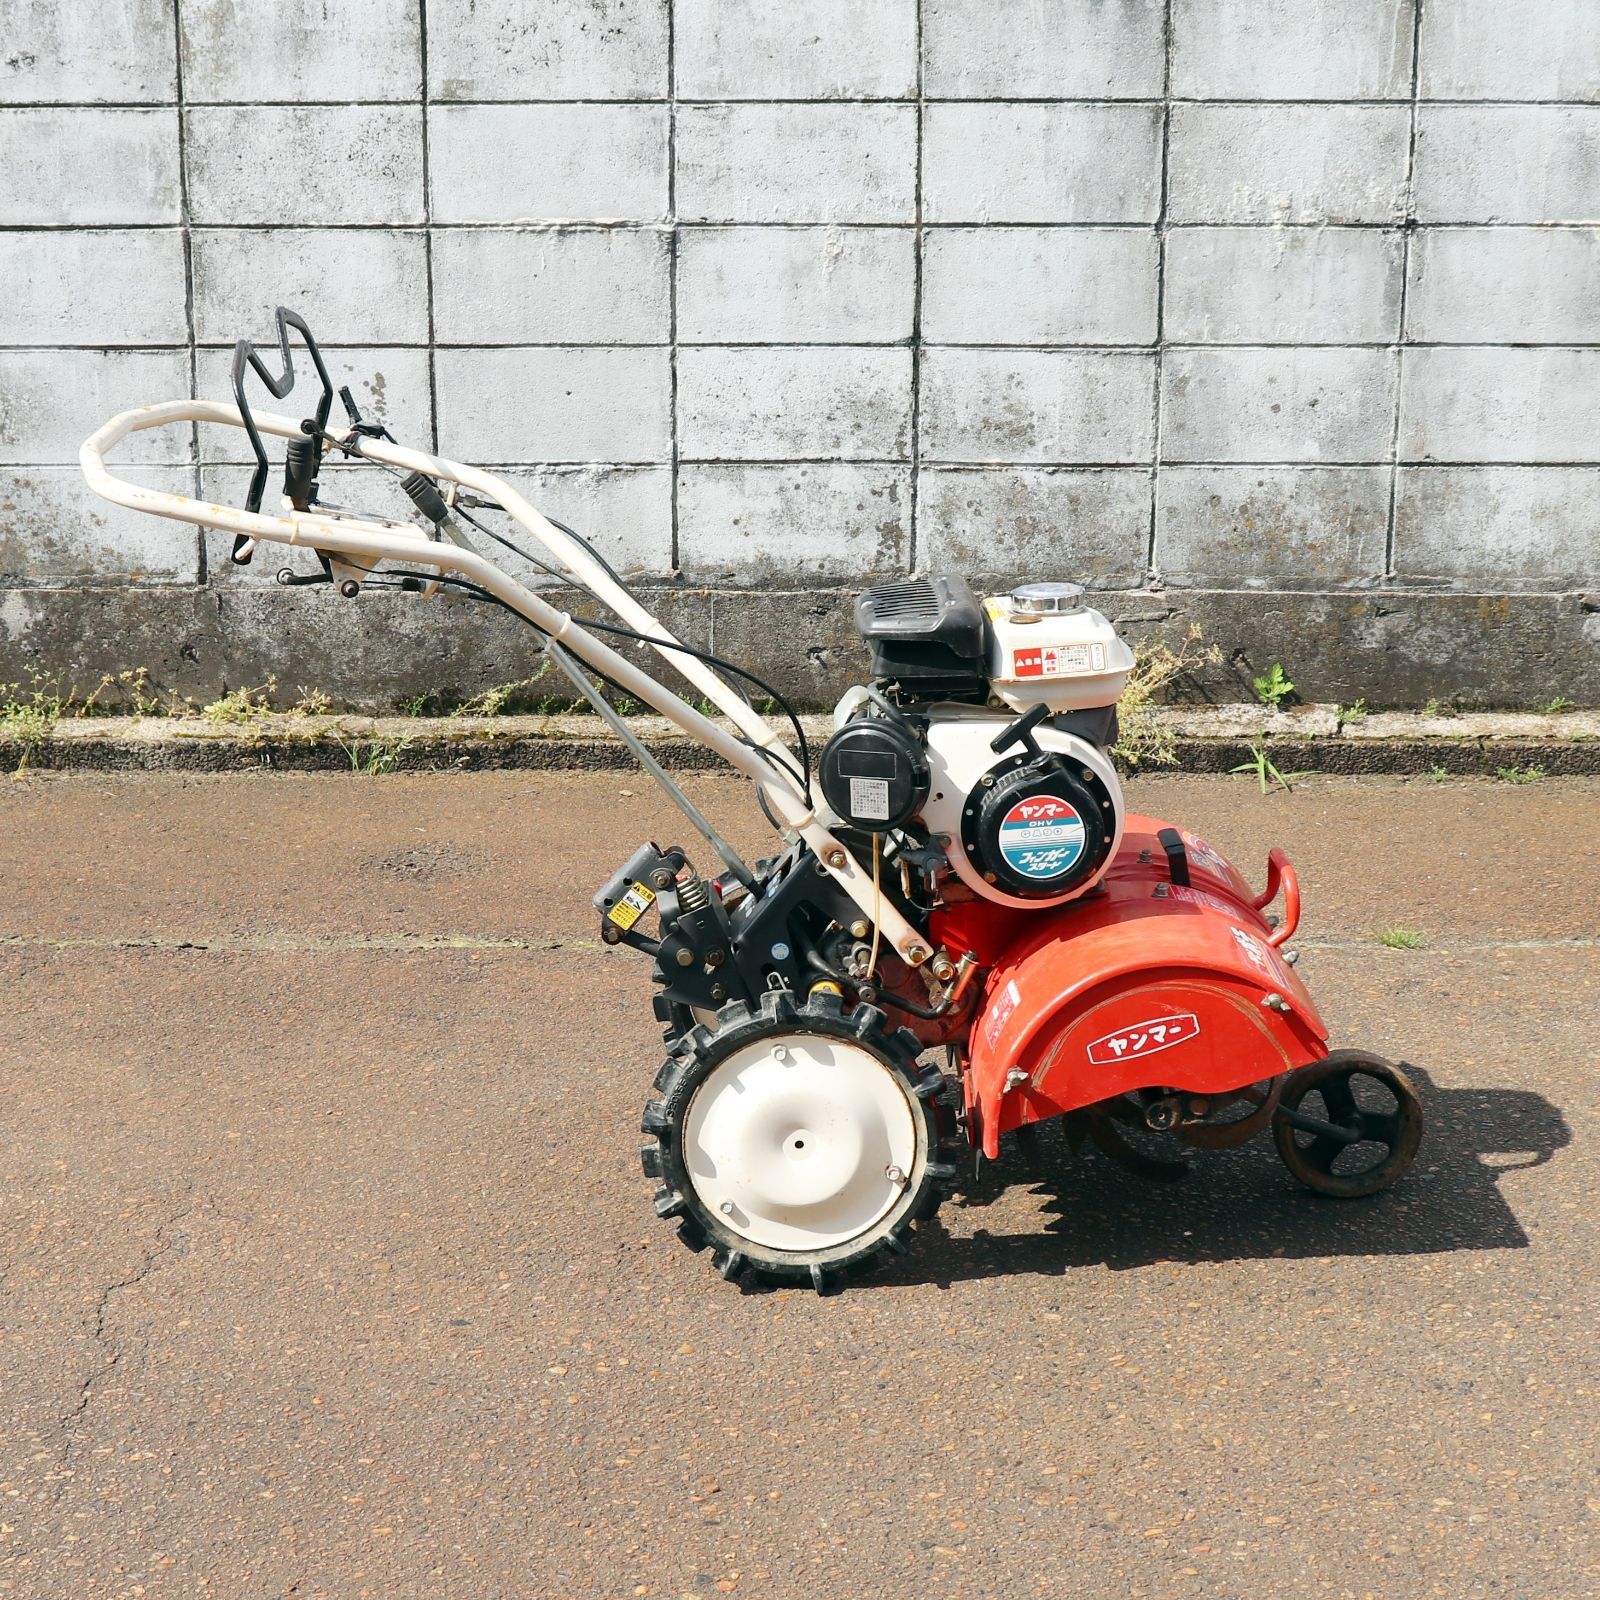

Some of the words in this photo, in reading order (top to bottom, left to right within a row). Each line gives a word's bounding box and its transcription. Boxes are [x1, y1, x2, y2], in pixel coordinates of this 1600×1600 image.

[1020, 803, 1064, 819] ヤンマー
[1018, 848, 1070, 864] フィンガー
[1027, 861, 1062, 871] スタート
[1108, 1025, 1181, 1056] ヤンマー
